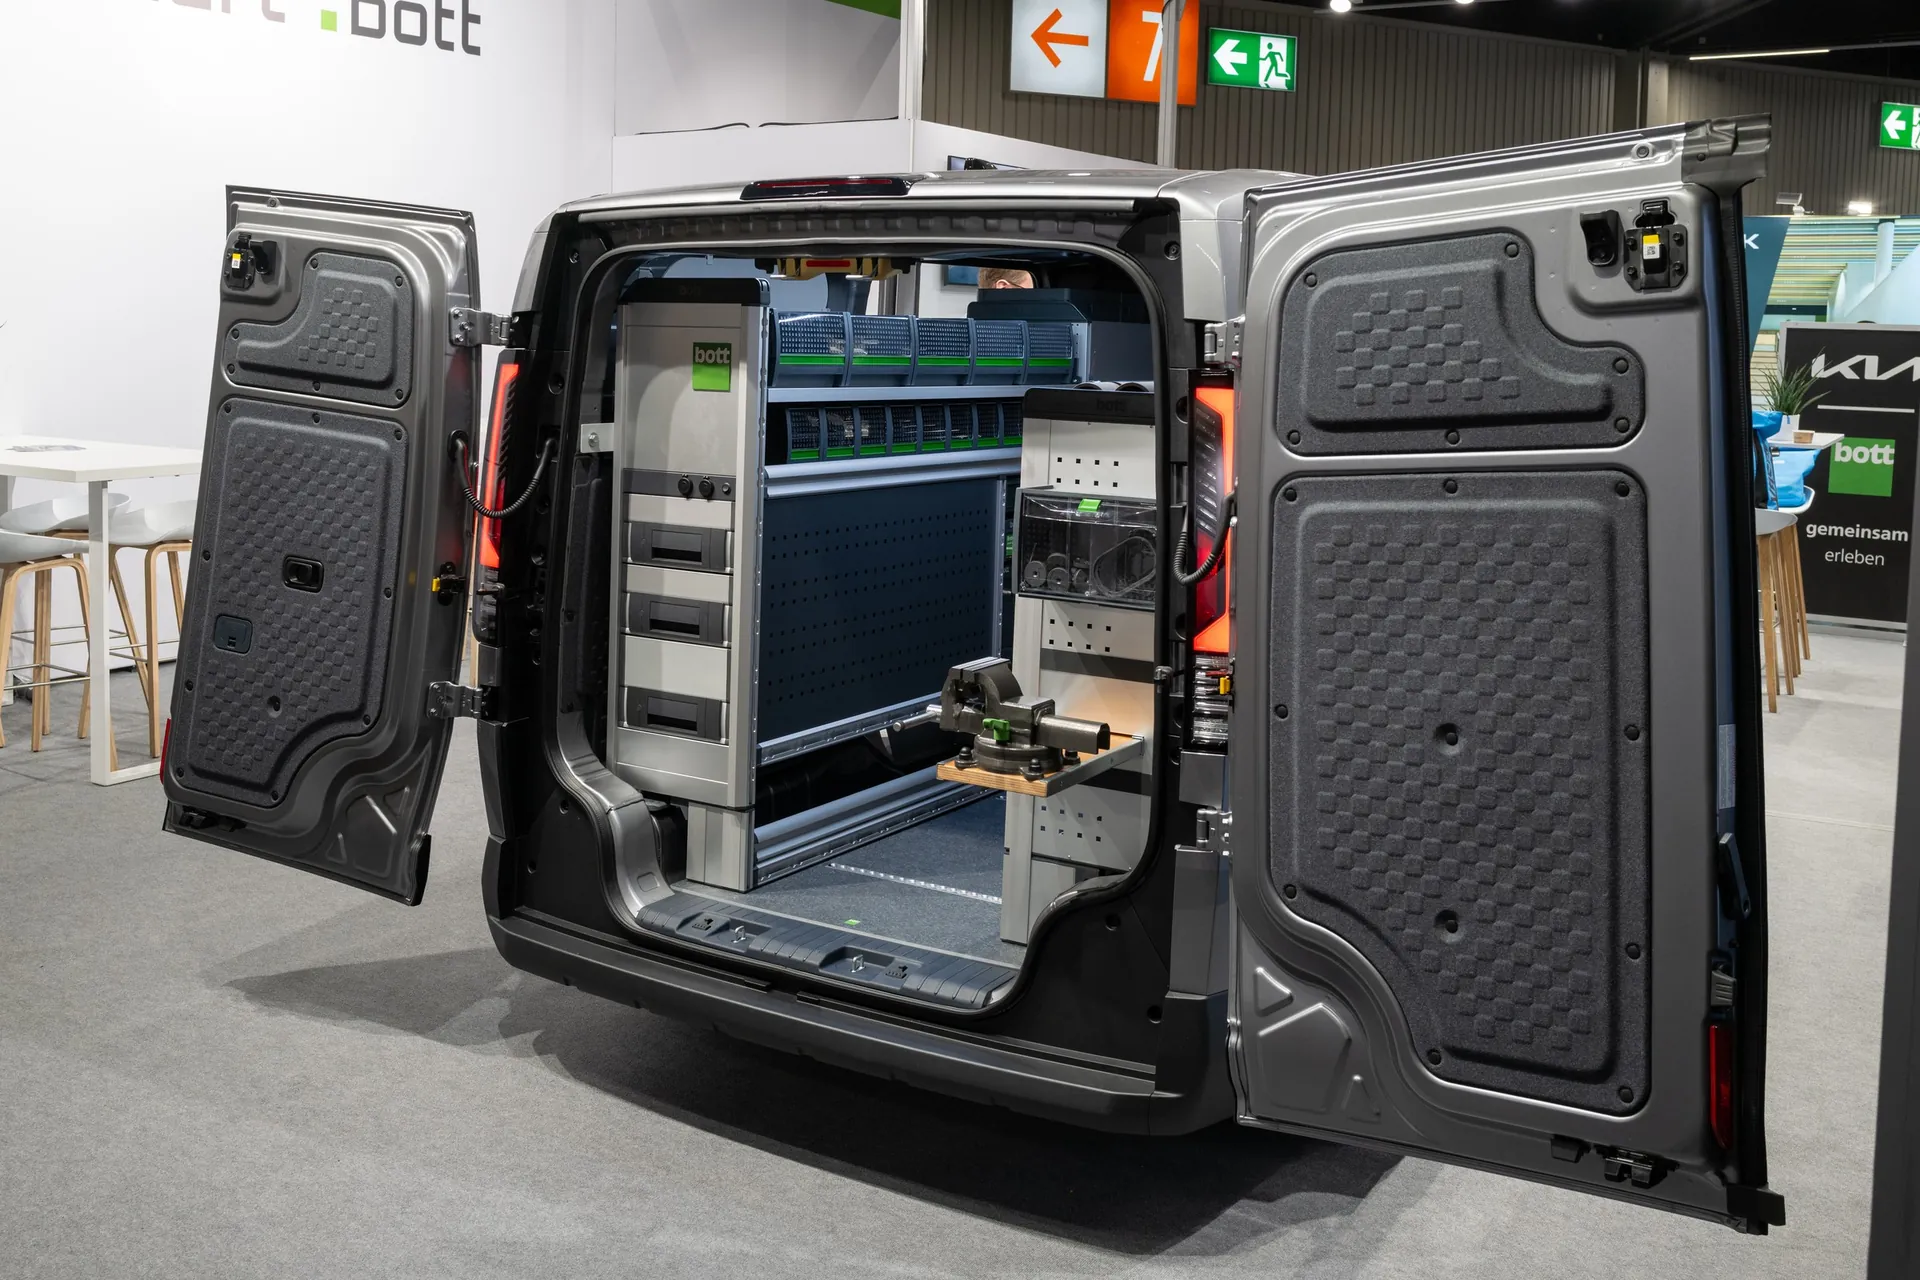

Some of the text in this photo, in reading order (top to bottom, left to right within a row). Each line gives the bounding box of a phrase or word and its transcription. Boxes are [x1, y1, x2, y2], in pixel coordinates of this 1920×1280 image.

[1142, 10, 1164, 82] 7
[694, 346, 730, 364] bott
[1834, 441, 1895, 465] bott
[1805, 523, 1909, 542] gemeinsam
[1824, 548, 1885, 566] erleben
